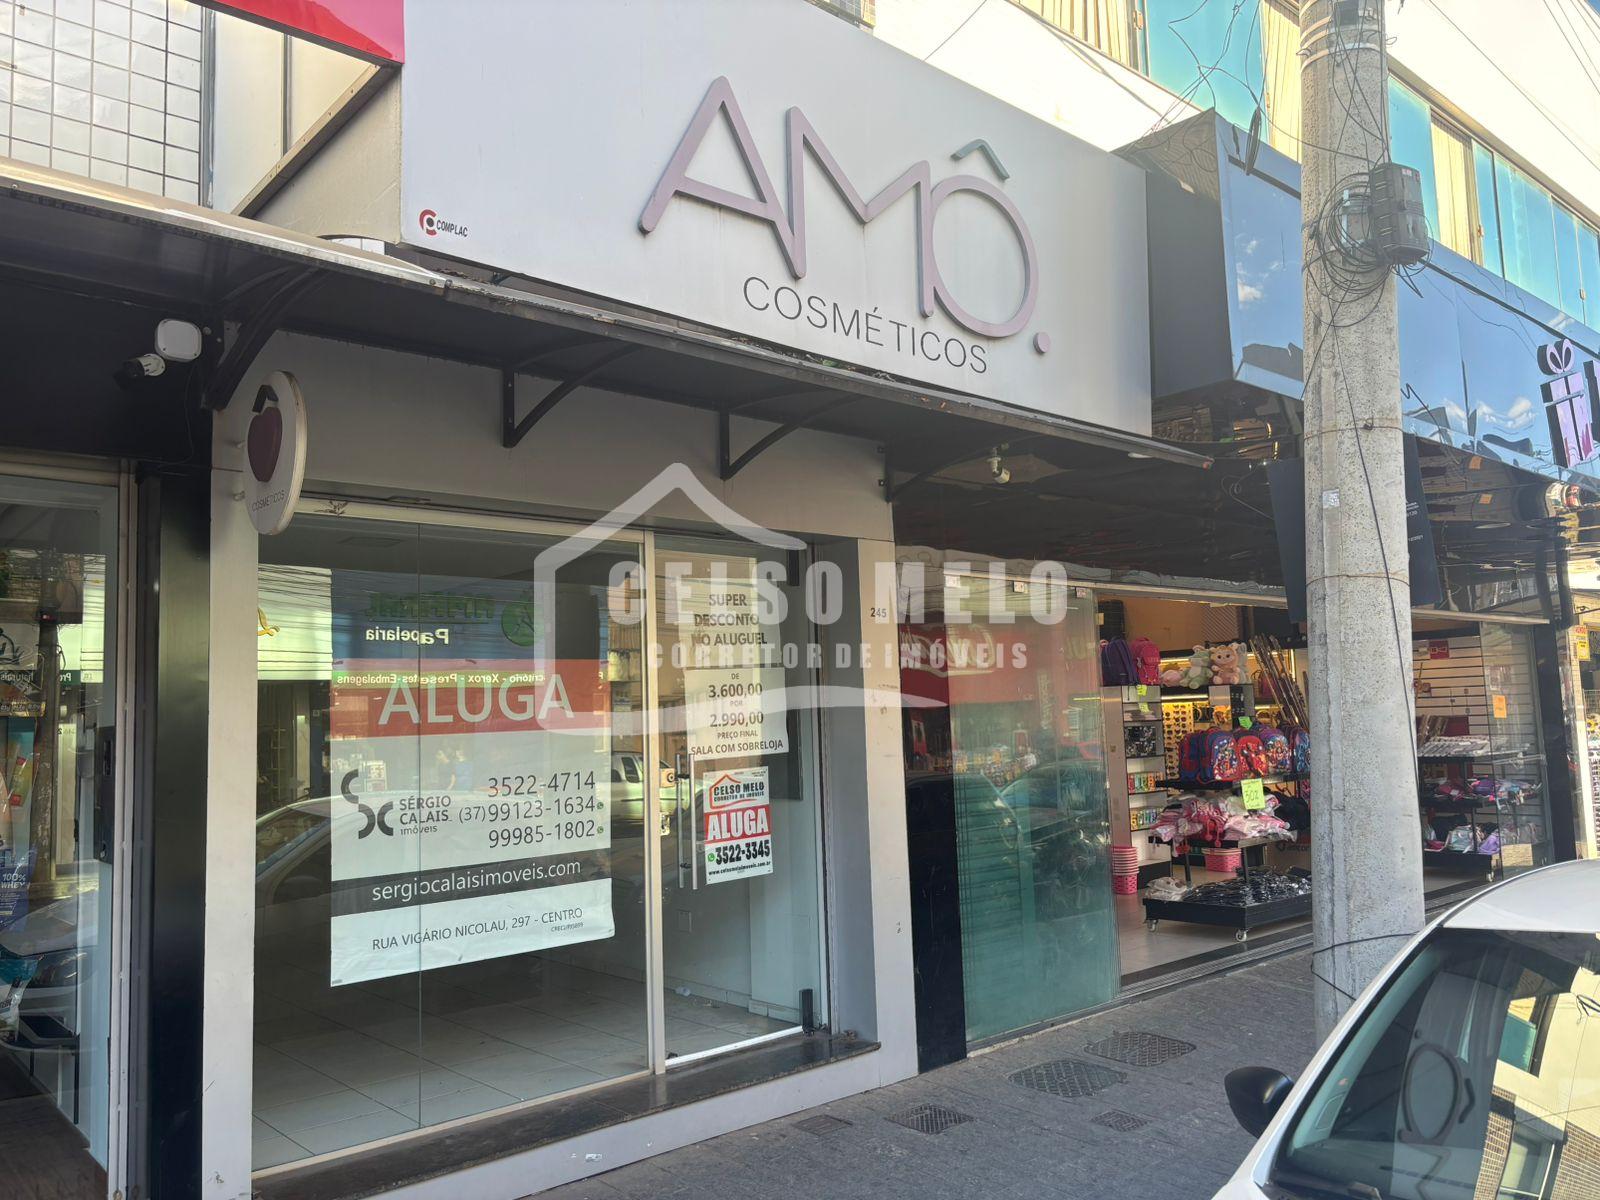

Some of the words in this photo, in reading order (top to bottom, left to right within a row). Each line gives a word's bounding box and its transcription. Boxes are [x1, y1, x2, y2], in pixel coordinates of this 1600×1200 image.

[436, 219, 468, 237] COMPLAC
[743, 276, 988, 374] COSMÉTICOS
[708, 593, 748, 607] SUPER
[693, 613, 760, 627] DESCONTO
[870, 607, 888, 618] 245
[713, 632, 768, 646] ALUGUEL
[708, 683, 763, 699] 3.600,00
[377, 673, 575, 726] ALUGA
[709, 711, 764, 728] 2.990,00
[717, 732, 738, 740] PREÇO
[739, 730, 758, 738] FINAL
[691, 745, 714, 756] SALA
[715, 742, 736, 753] COM
[737, 739, 784, 753] SOBRELOJA
[488, 770, 596, 798] 3522-4714
[713, 784, 741, 796] CELSO
[743, 781, 765, 792] MELO
[399, 795, 452, 811] SÉRGIO
[399, 809, 450, 825] CALAIS
[708, 808, 769, 841] ALUGA
[400, 824, 438, 836] imóveis
[488, 820, 596, 849] 99985-1802
[715, 839, 771, 866] 3522-3345
[1, 881, 26, 889] WHEY
[372, 858, 582, 902] sergiocalaisimoveis.com
[372, 936, 399, 950] RUA
[401, 928, 451, 946] VIGÁRIO
[511, 916, 531, 929] 297
[541, 907, 583, 924] CENTRO
